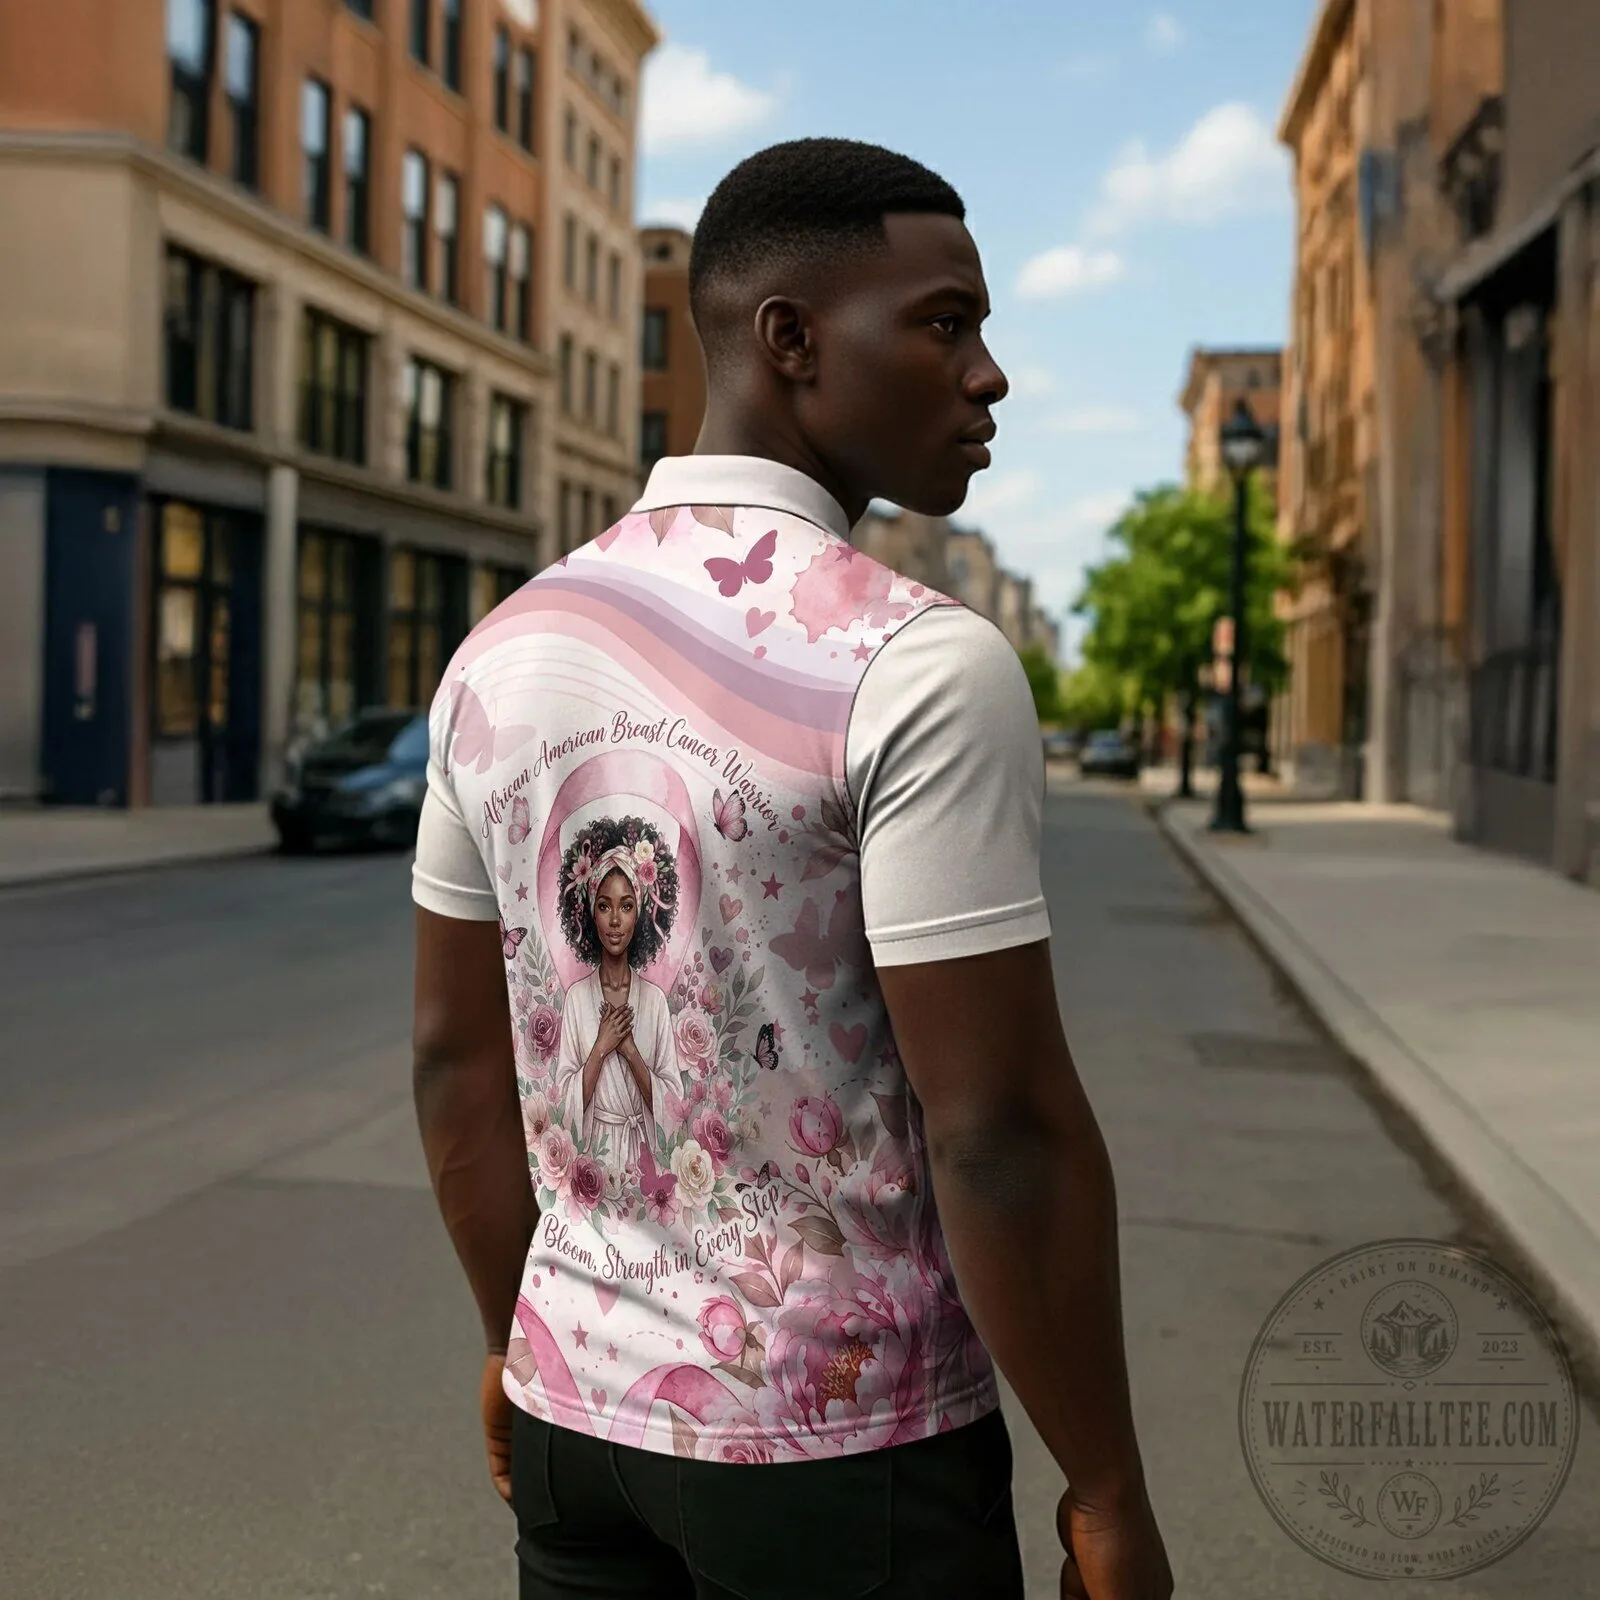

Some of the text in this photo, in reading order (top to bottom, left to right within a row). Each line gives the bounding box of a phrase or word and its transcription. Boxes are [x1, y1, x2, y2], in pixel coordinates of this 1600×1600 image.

[482, 711, 779, 838] African American Breast Cancer Warrior
[543, 1183, 781, 1294] Bloom, Strength in Every Step
